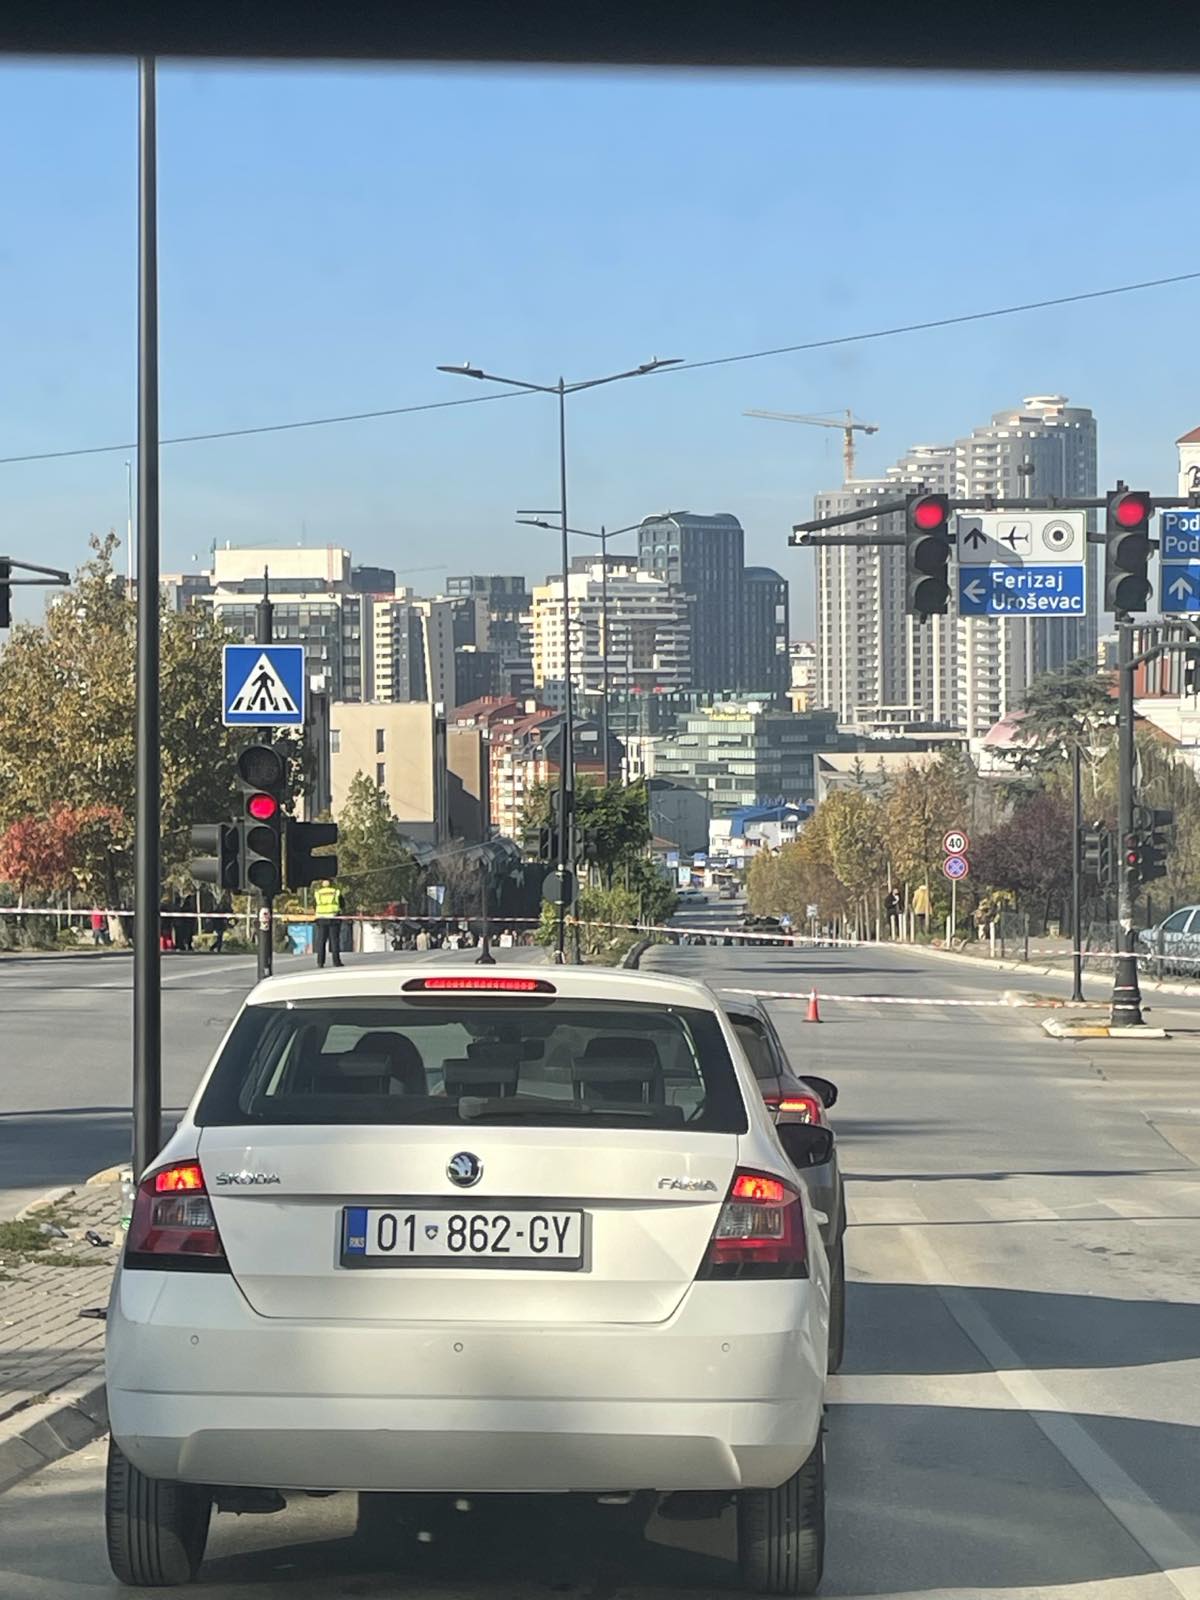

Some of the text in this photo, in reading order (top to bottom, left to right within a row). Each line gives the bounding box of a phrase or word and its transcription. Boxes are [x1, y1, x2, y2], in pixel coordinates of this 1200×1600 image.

[992, 571, 1063, 592] Ferizaj
[992, 592, 1081, 610] Uroševac
[948, 838, 962, 848] 40
[377, 1213, 416, 1251] 01
